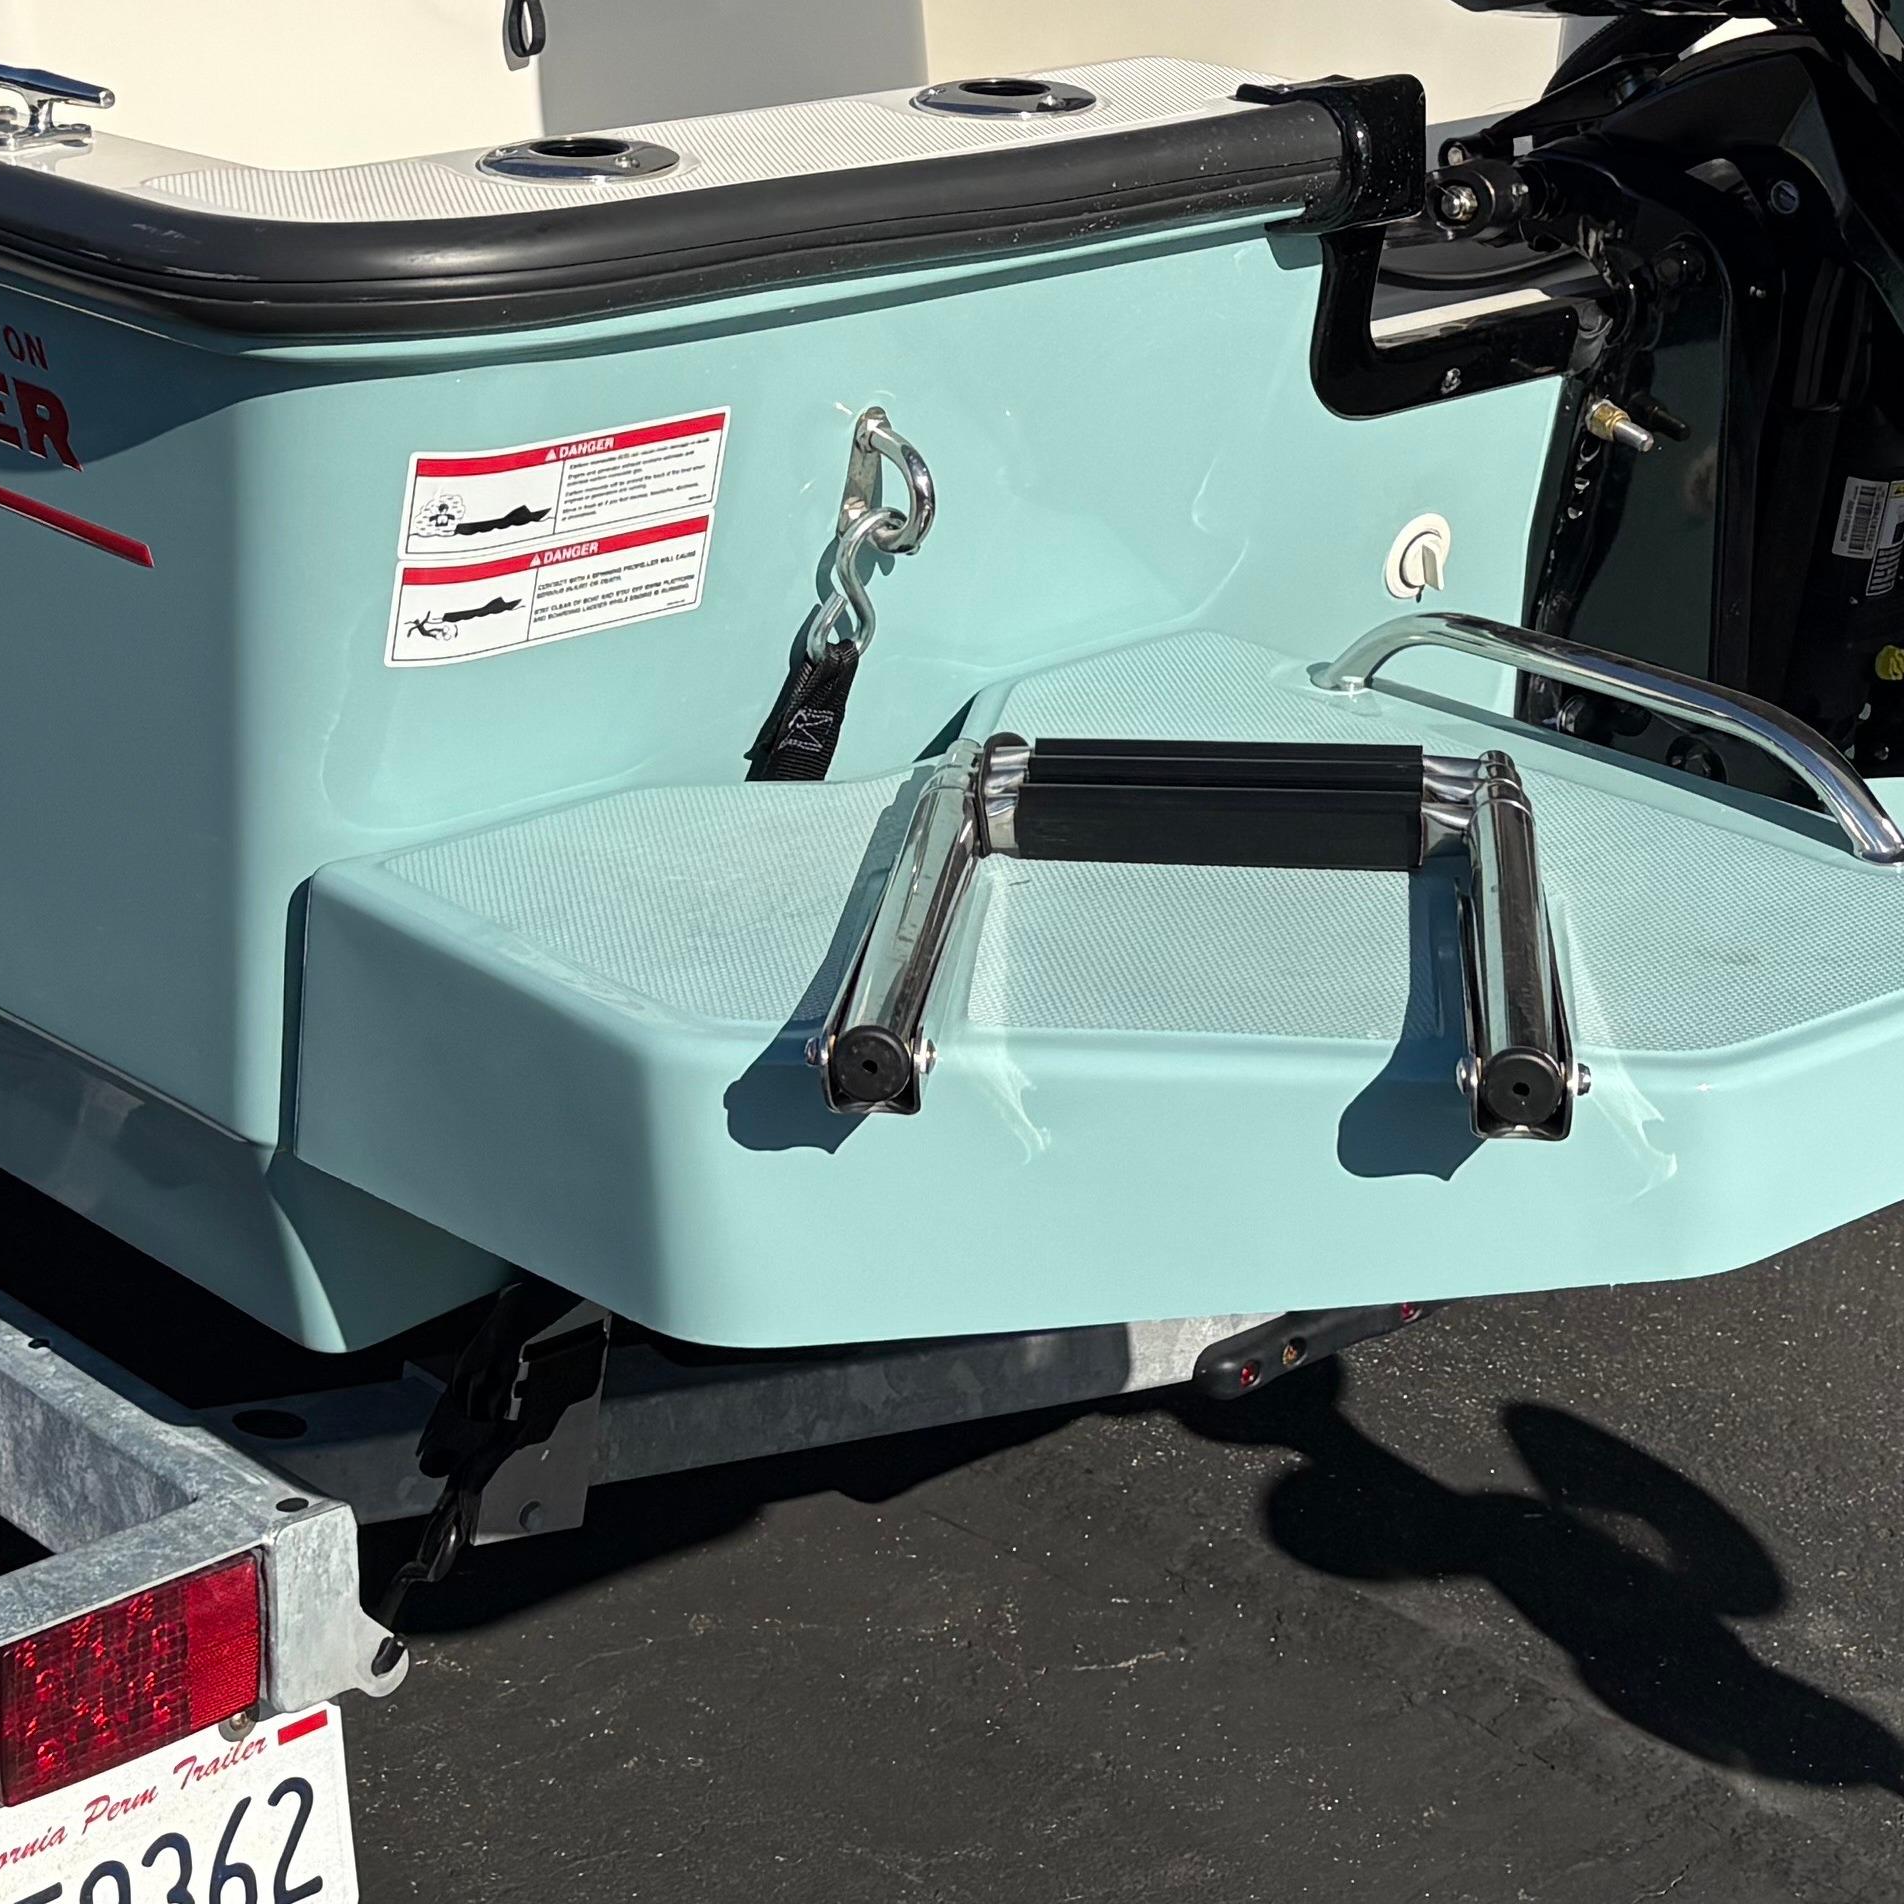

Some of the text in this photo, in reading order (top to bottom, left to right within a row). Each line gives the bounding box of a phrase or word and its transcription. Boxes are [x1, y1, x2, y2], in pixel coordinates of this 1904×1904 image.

[559, 437, 615, 460] DANGER
[543, 542, 599, 565] DANGER
[81, 1786, 157, 1836] Perm
[172, 1736, 267, 1791] Trailer
